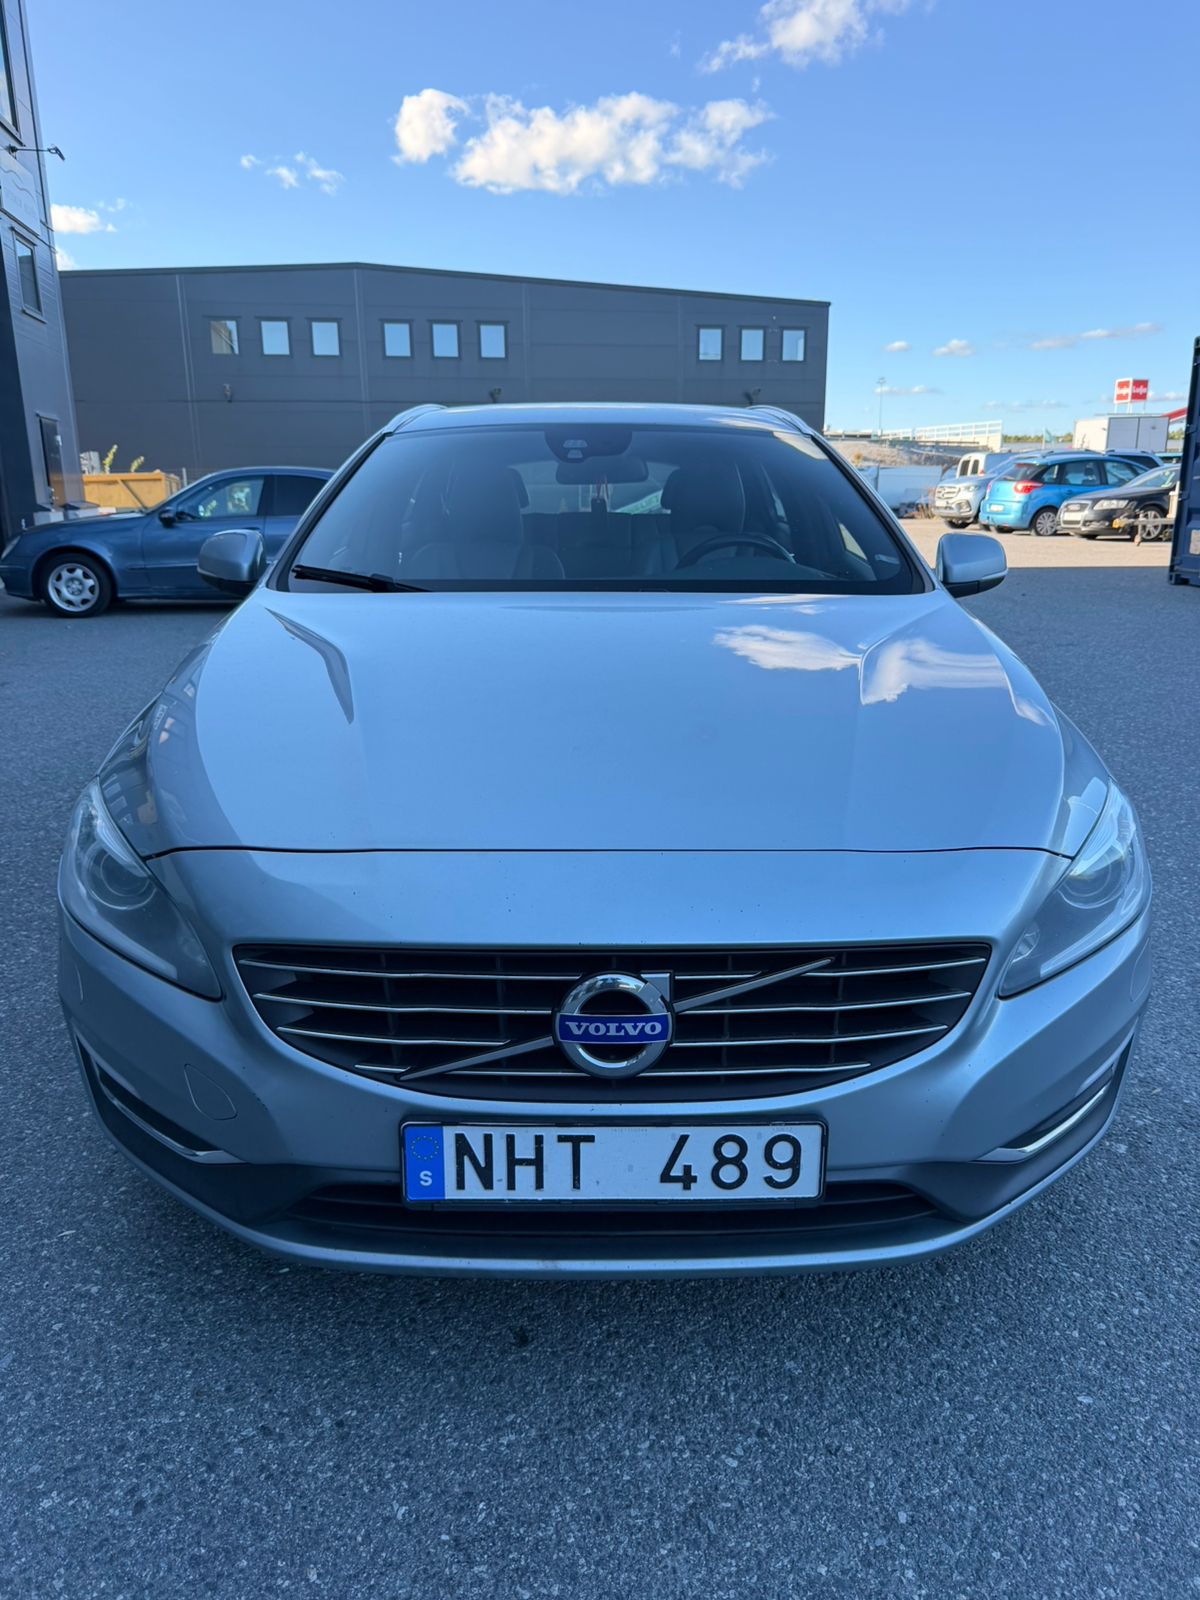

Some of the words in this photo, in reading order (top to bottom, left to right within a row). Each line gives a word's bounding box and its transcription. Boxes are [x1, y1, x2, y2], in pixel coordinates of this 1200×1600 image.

[565, 1021, 662, 1036] VOLVO
[454, 1132, 596, 1191] NHT
[659, 1133, 802, 1191] 489
[419, 1170, 432, 1186] S
